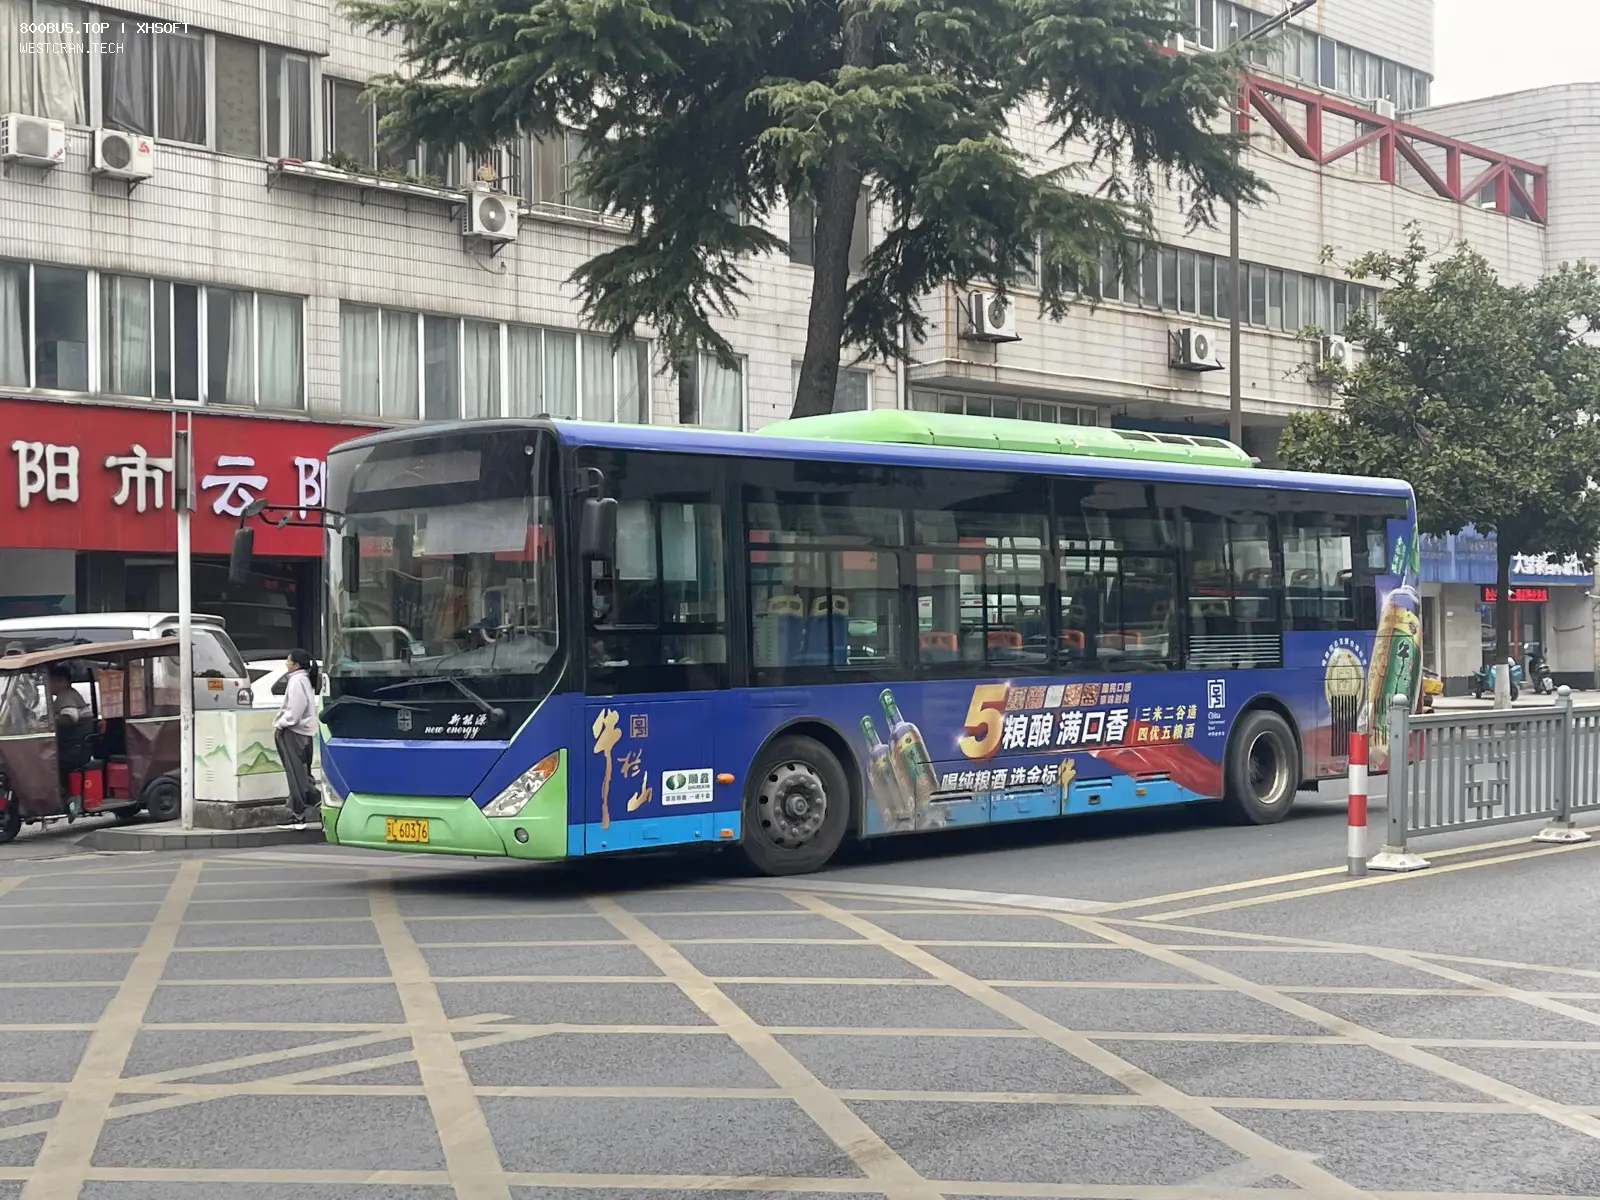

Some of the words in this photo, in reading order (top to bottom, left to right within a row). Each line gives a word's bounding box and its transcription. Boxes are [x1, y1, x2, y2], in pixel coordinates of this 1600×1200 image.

[446, 726, 479, 739] energy
[1056, 708, 1129, 746] 满口香
[1137, 723, 1196, 741] 四优五粮酒
